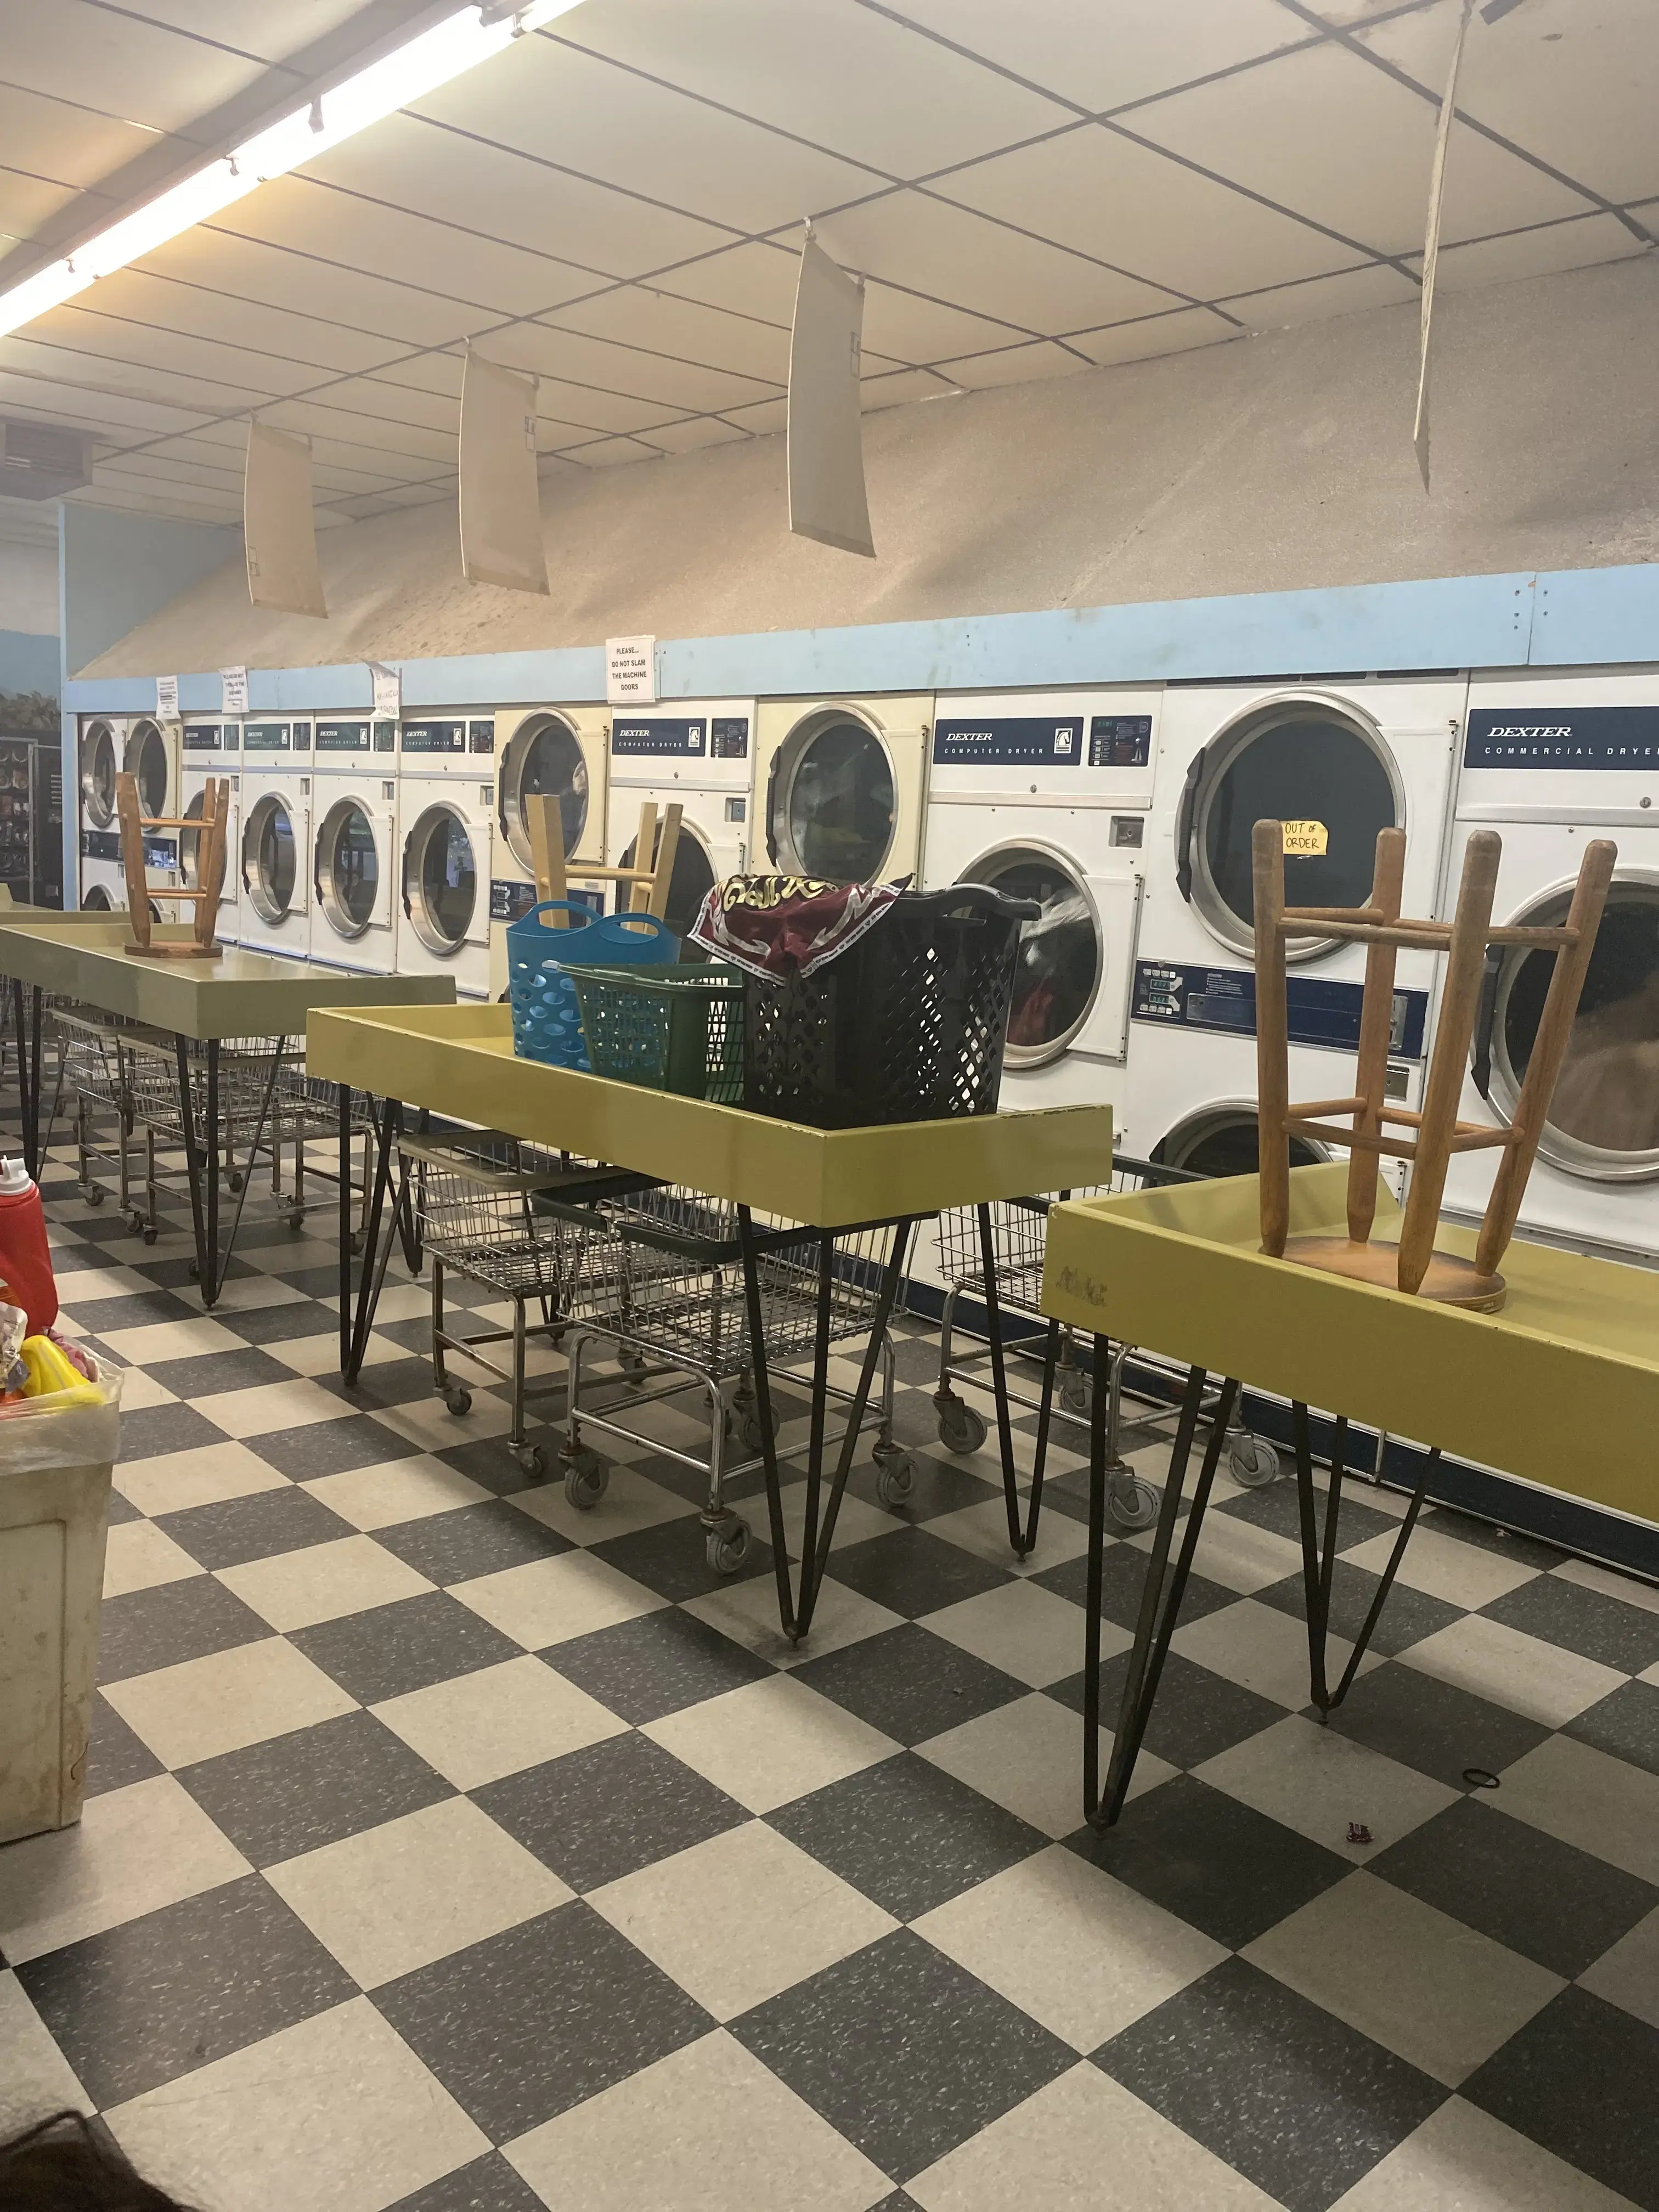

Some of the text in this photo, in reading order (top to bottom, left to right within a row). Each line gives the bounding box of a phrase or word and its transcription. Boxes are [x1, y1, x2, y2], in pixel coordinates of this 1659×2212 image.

[945, 732, 993, 741] DEXTER
[1486, 726, 1572, 737] DEXTER
[1285, 822, 1306, 834] OUT
[1286, 837, 1319, 849] ORDER
